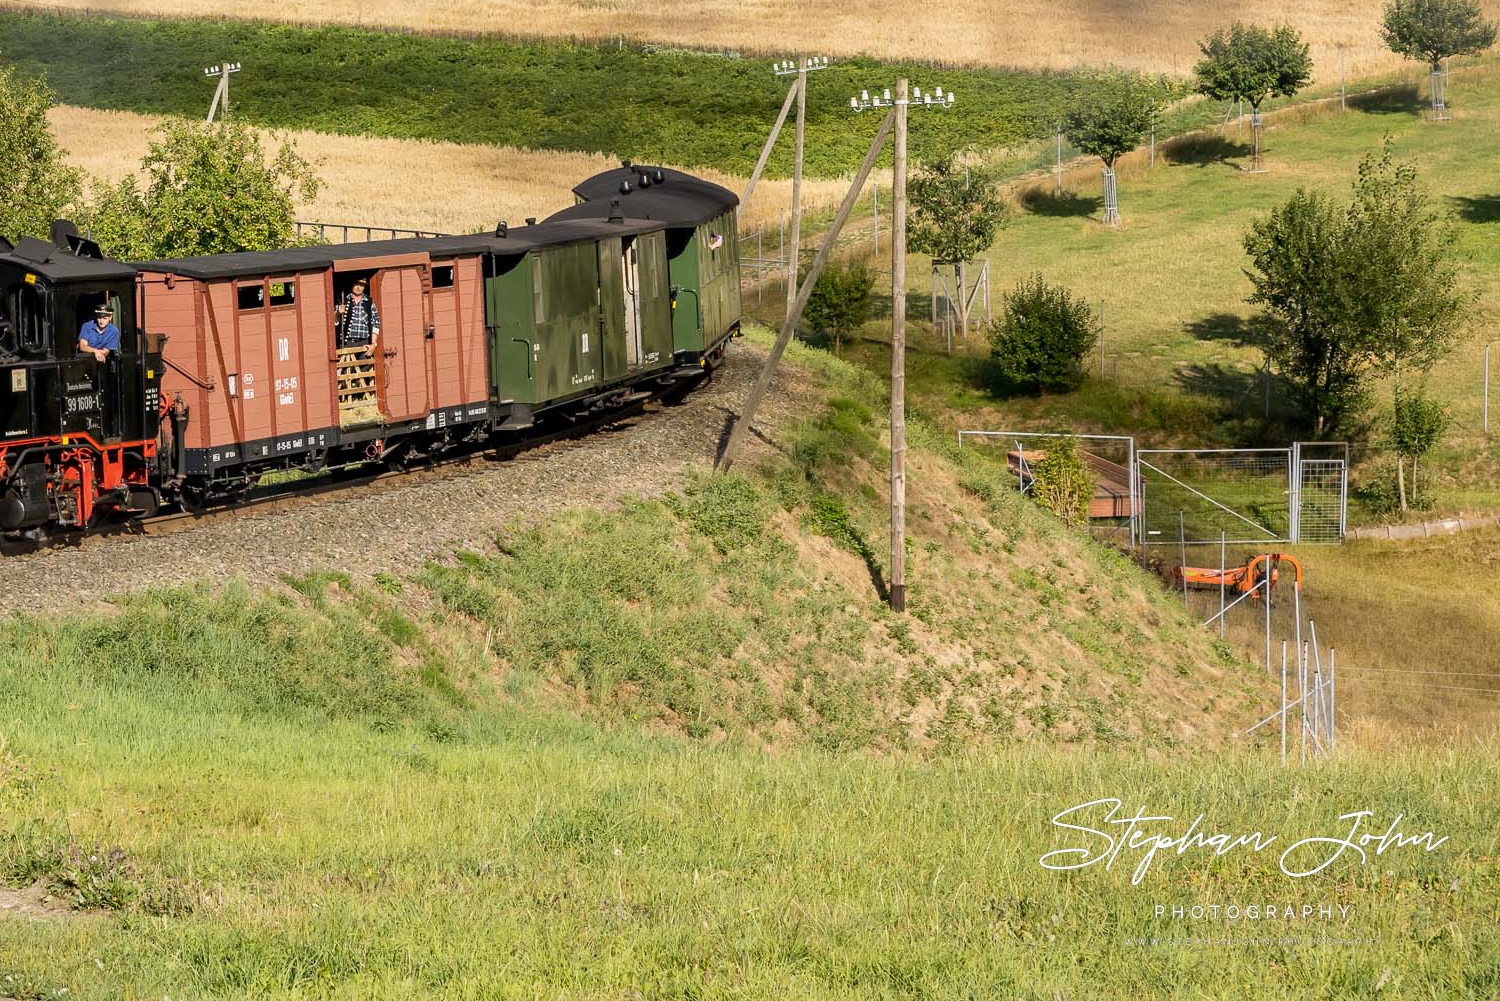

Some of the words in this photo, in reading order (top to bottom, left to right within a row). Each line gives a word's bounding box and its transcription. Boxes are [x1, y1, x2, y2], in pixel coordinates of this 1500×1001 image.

[279, 338, 289, 361] DR
[67, 398, 77, 411] 99
[77, 394, 99, 411] 1608-1
